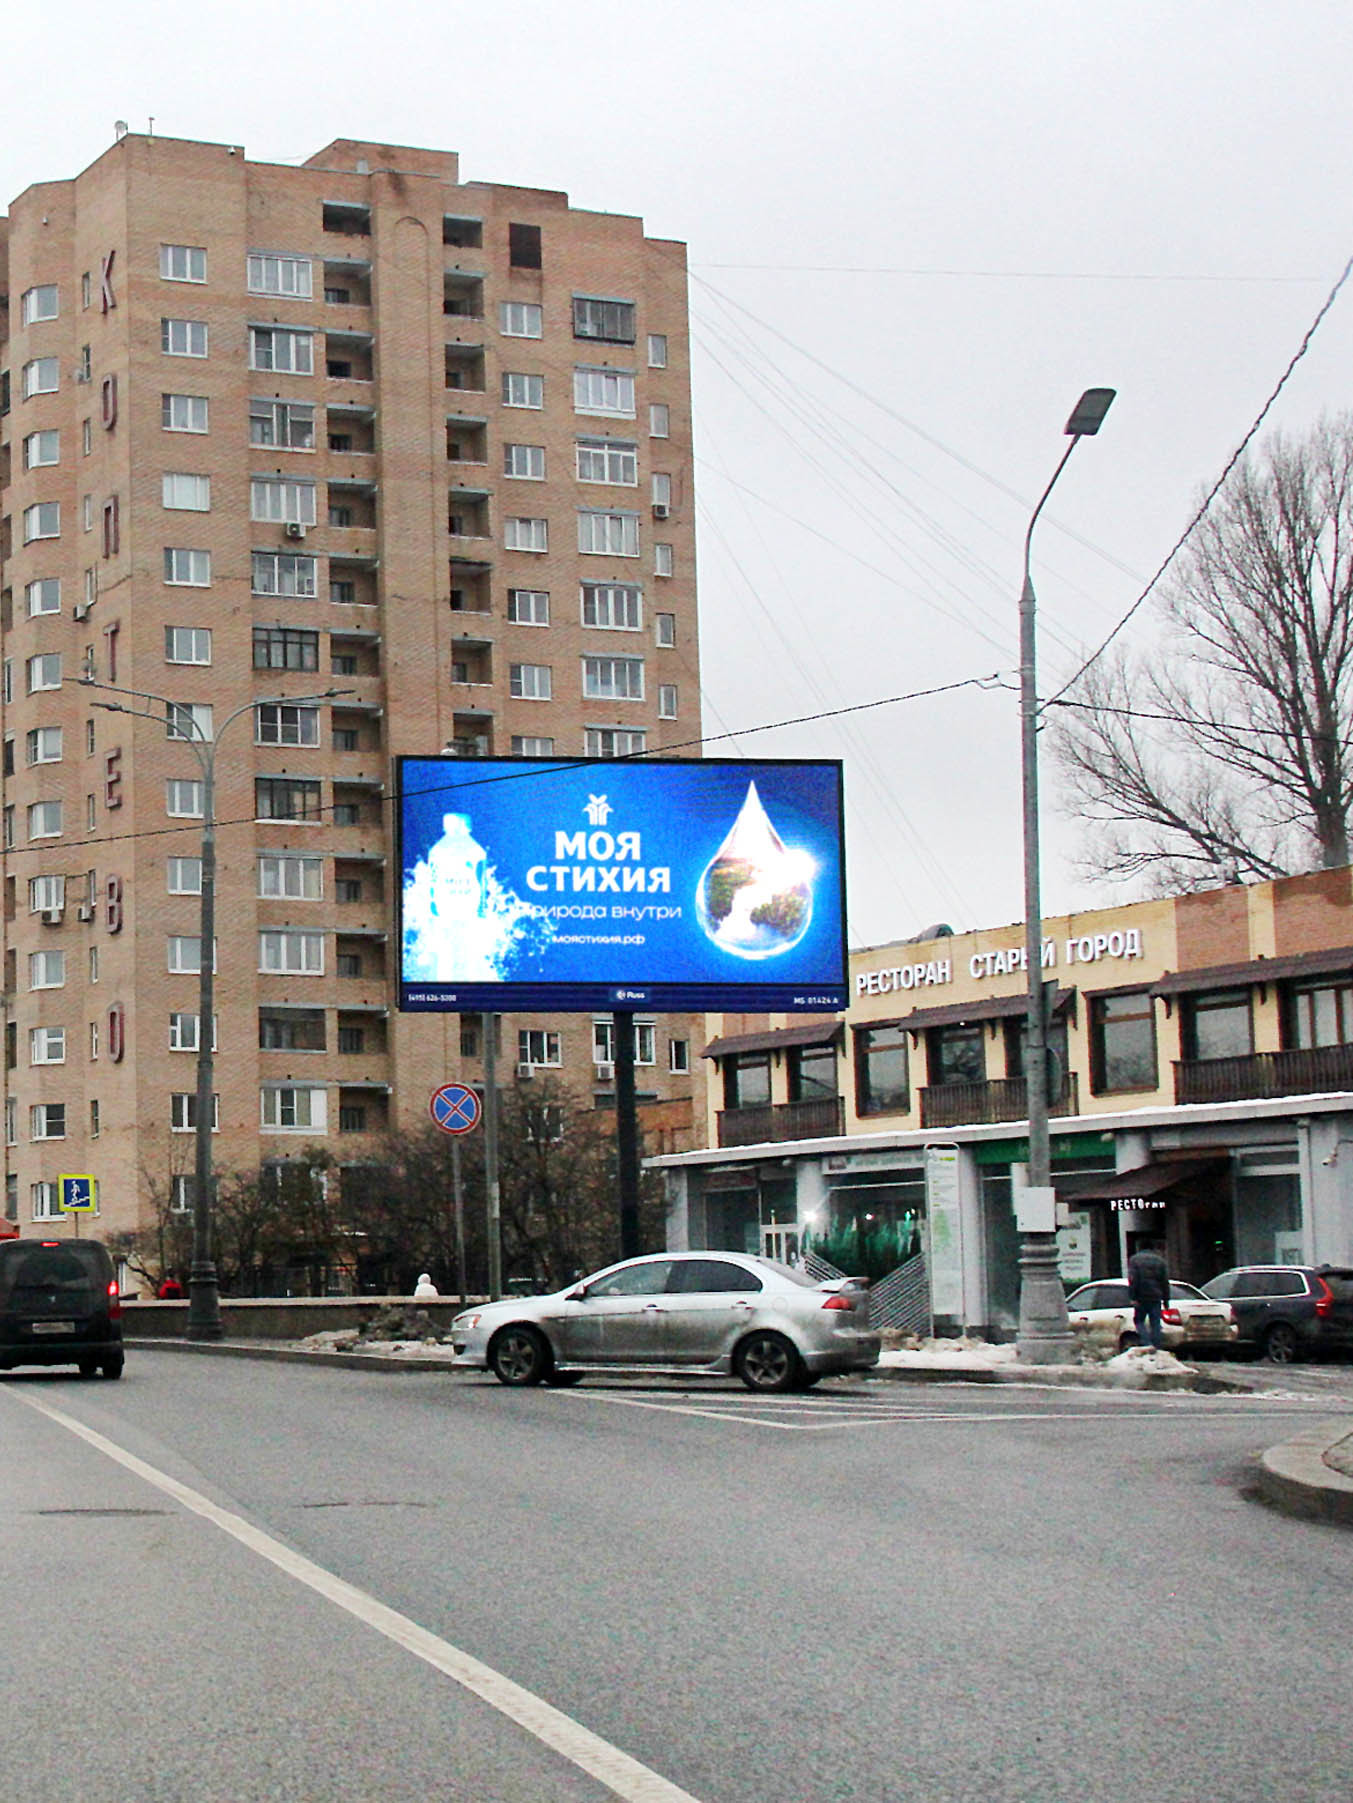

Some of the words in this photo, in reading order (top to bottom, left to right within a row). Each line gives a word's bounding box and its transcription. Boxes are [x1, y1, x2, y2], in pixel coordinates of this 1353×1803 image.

[555, 830, 641, 861] МОЯ
[526, 865, 671, 893] СТИХИЯ
[521, 904, 607, 920] рирода
[612, 905, 682, 921] внутри
[552, 933, 645, 946] моястихия.рф
[855, 959, 953, 997] РЕСТОРАН
[1065, 928, 1143, 965] ГОРОД
